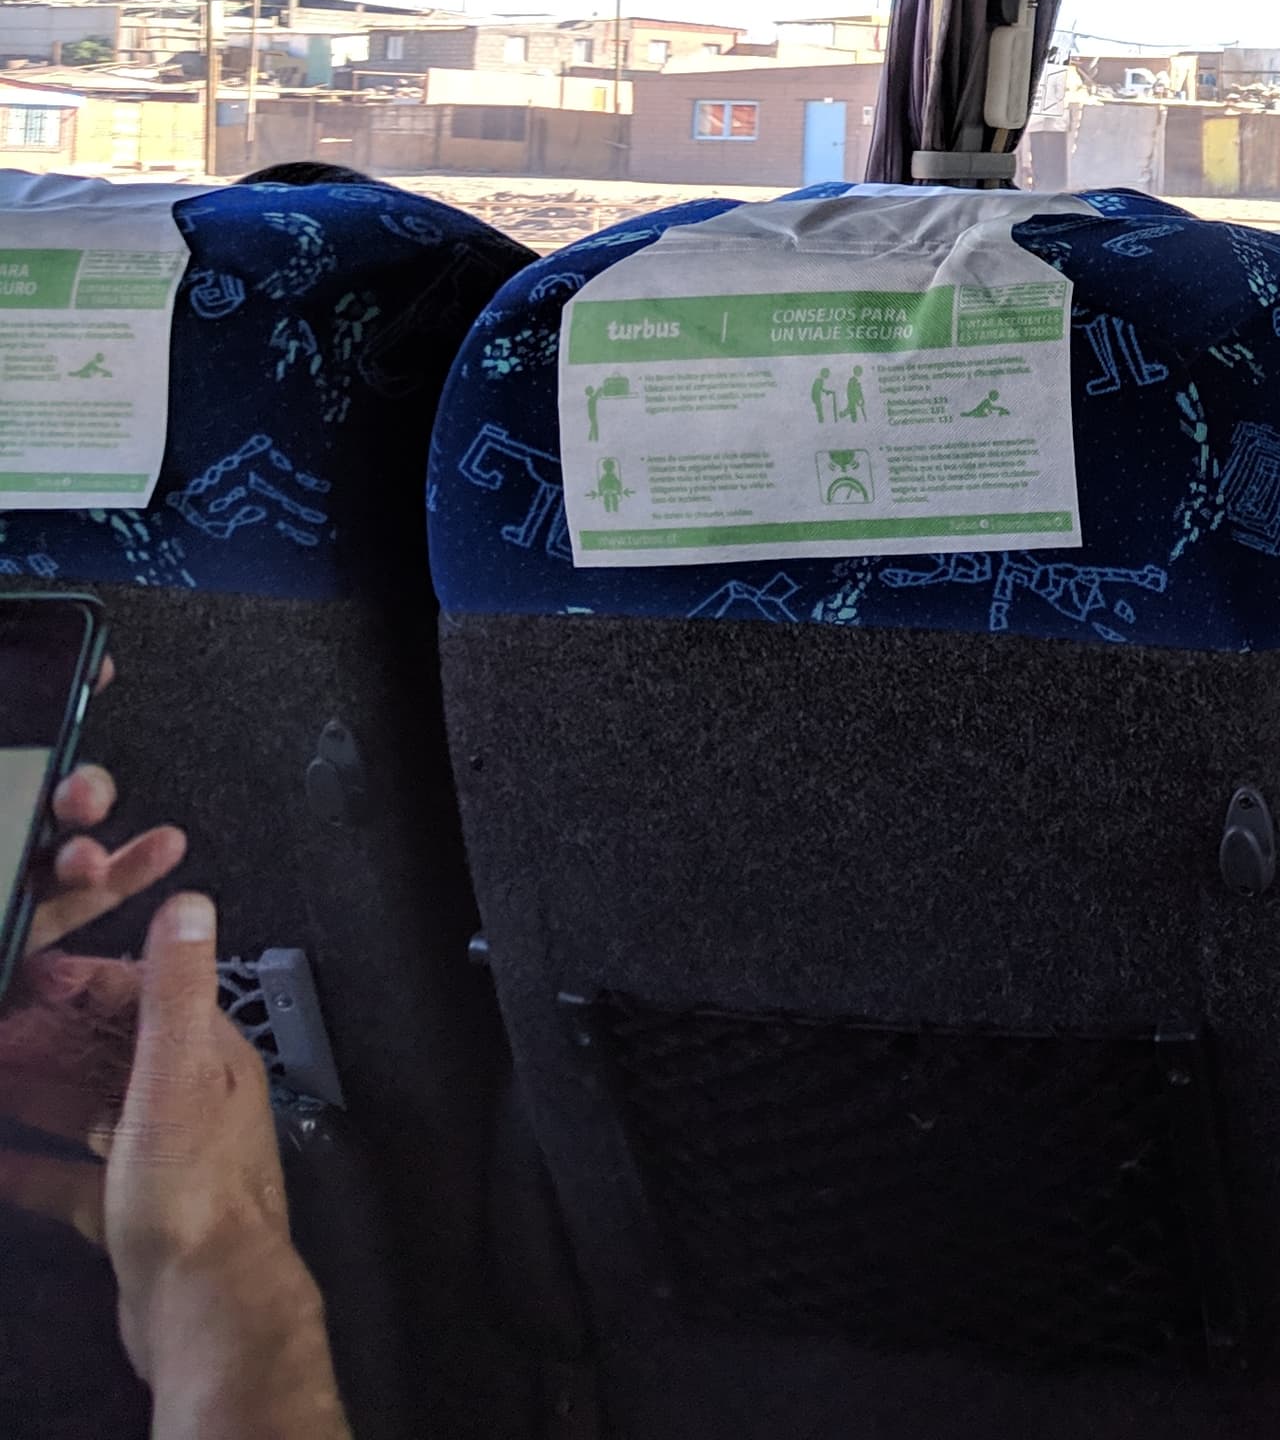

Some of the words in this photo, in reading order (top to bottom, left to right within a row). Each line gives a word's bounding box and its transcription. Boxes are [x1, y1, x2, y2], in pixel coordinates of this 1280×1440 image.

[772, 308, 856, 323] CONSEJOS
[861, 307, 907, 321] PARA
[606, 319, 680, 341] turbus
[771, 327, 794, 341] UN
[798, 326, 842, 341] VIAJE
[847, 324, 914, 340] SEGURO
